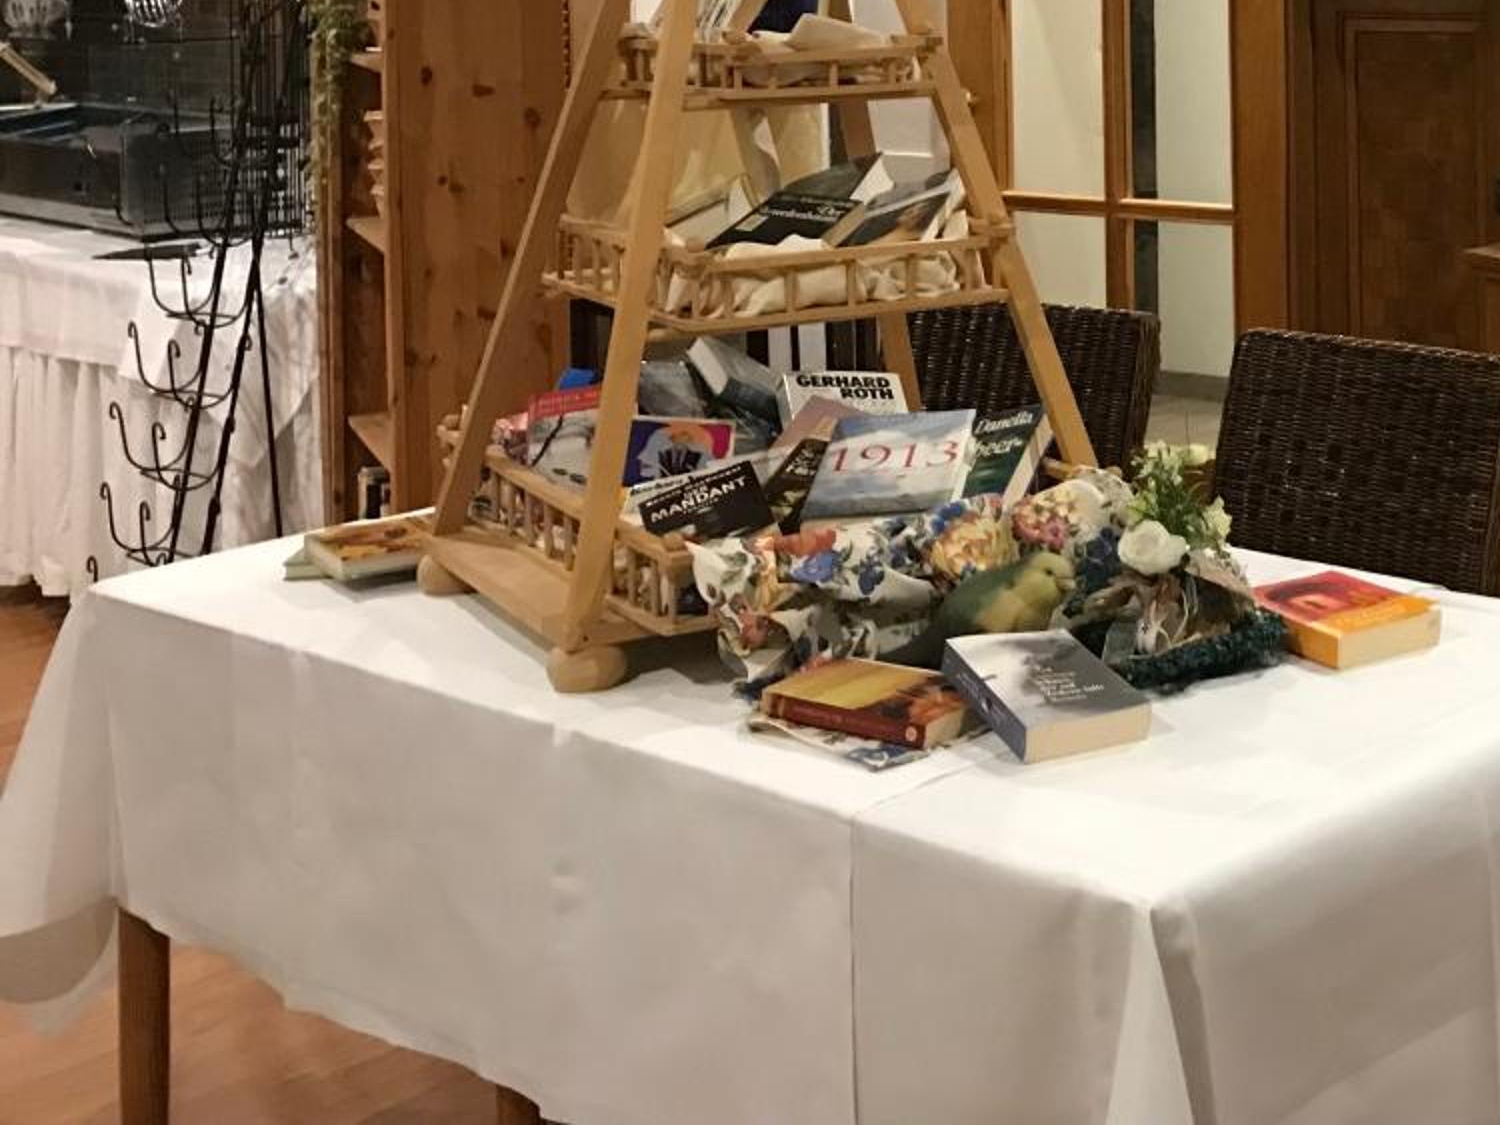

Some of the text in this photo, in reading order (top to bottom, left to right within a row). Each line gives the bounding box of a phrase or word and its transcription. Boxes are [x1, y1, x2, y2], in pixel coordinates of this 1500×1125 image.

[796, 375, 890, 388] GERHARD
[839, 388, 894, 400] ROTH
[832, 440, 960, 472] 1913
[650, 477, 747, 523] MANDANT
